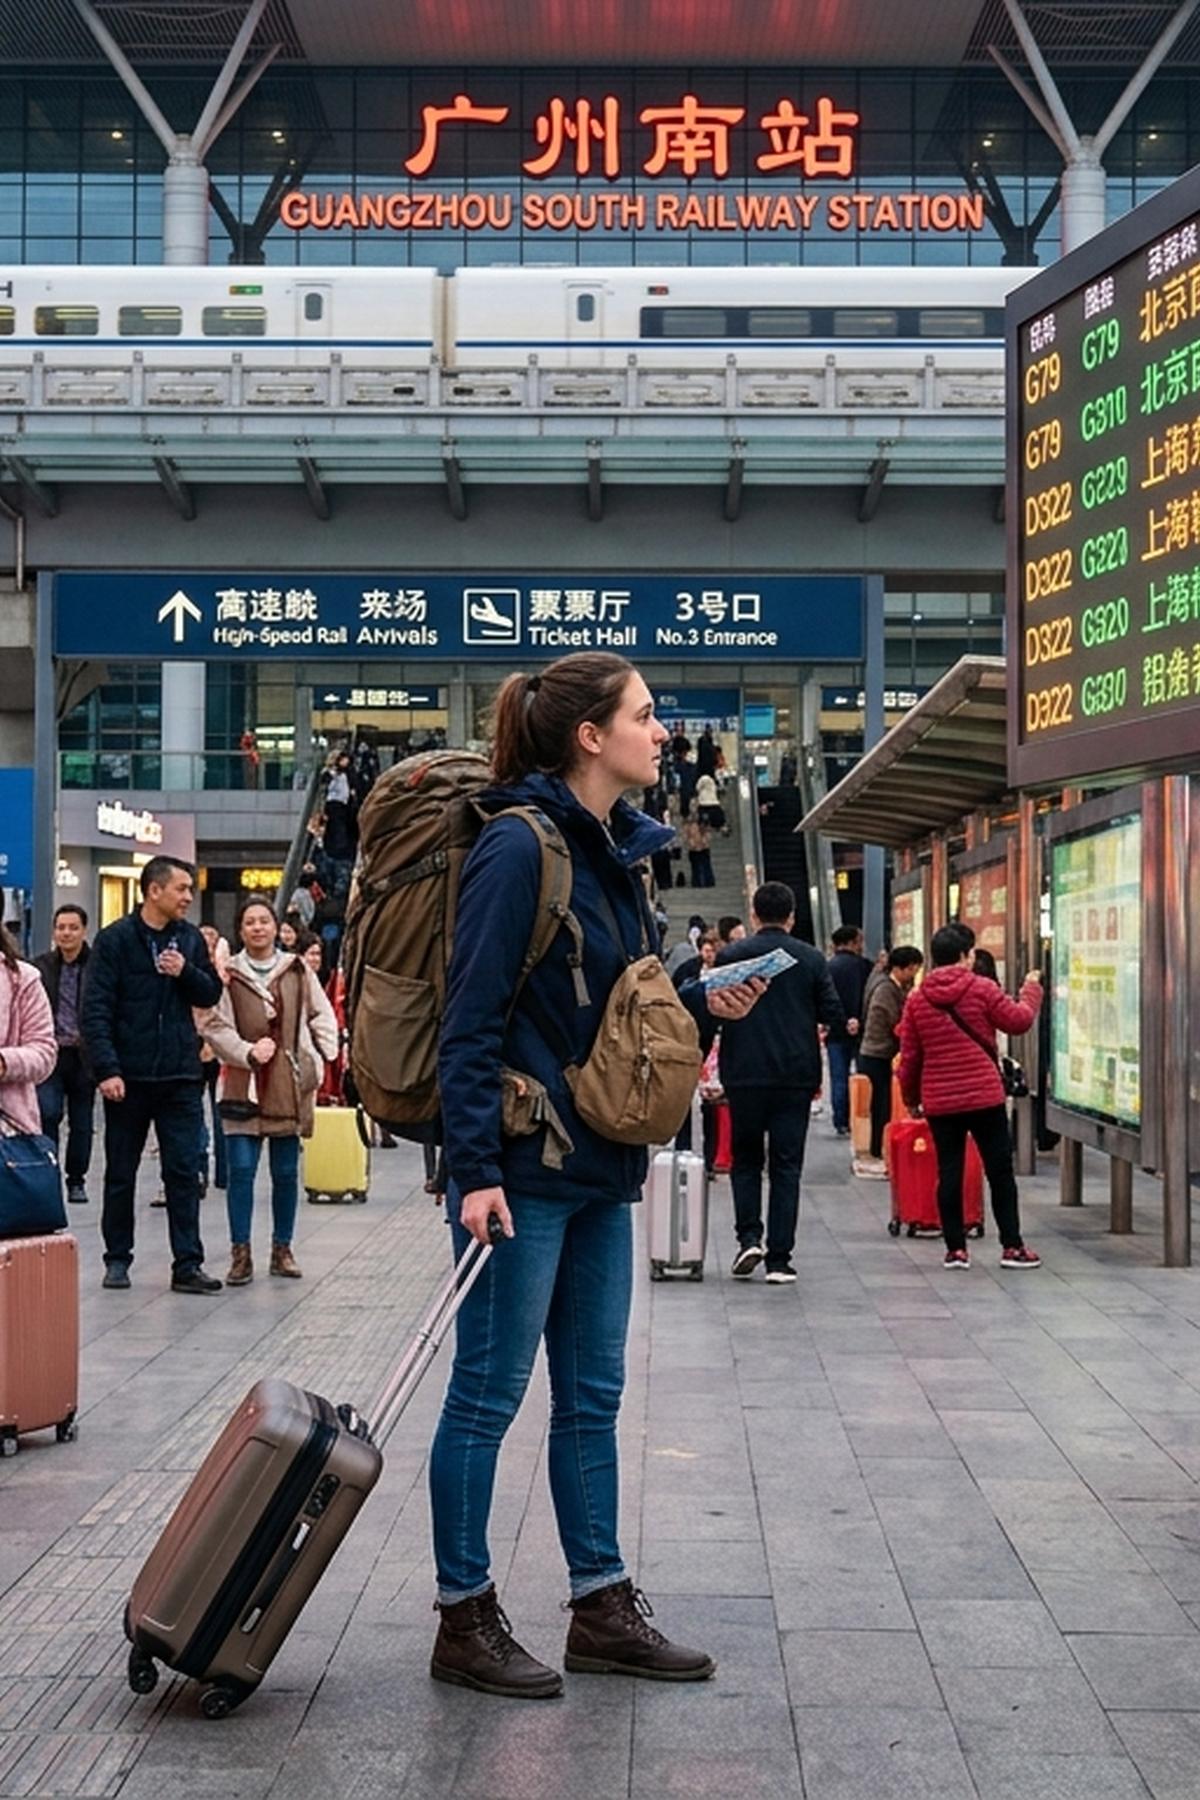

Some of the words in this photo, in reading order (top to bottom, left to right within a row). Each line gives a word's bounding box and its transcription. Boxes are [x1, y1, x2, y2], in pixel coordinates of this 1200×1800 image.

[404, 94, 860, 178] 广州南站
[280, 191, 511, 229] GUANGZHOU
[523, 193, 645, 229] SOUTH
[656, 193, 818, 230] RAILWAY
[828, 194, 984, 230] STATION
[1025, 352, 1061, 404] G79
[1082, 318, 1120, 371] G79
[1025, 419, 1061, 470] G79
[1025, 480, 1072, 536] D322
[1026, 549, 1072, 602] D322
[675, 590, 761, 624] 3号口
[527, 626, 592, 646] Ticket
[596, 626, 637, 645] Hall
[703, 628, 778, 646] Entrance
[1026, 616, 1073, 667] D322
[1026, 682, 1073, 732] D322
